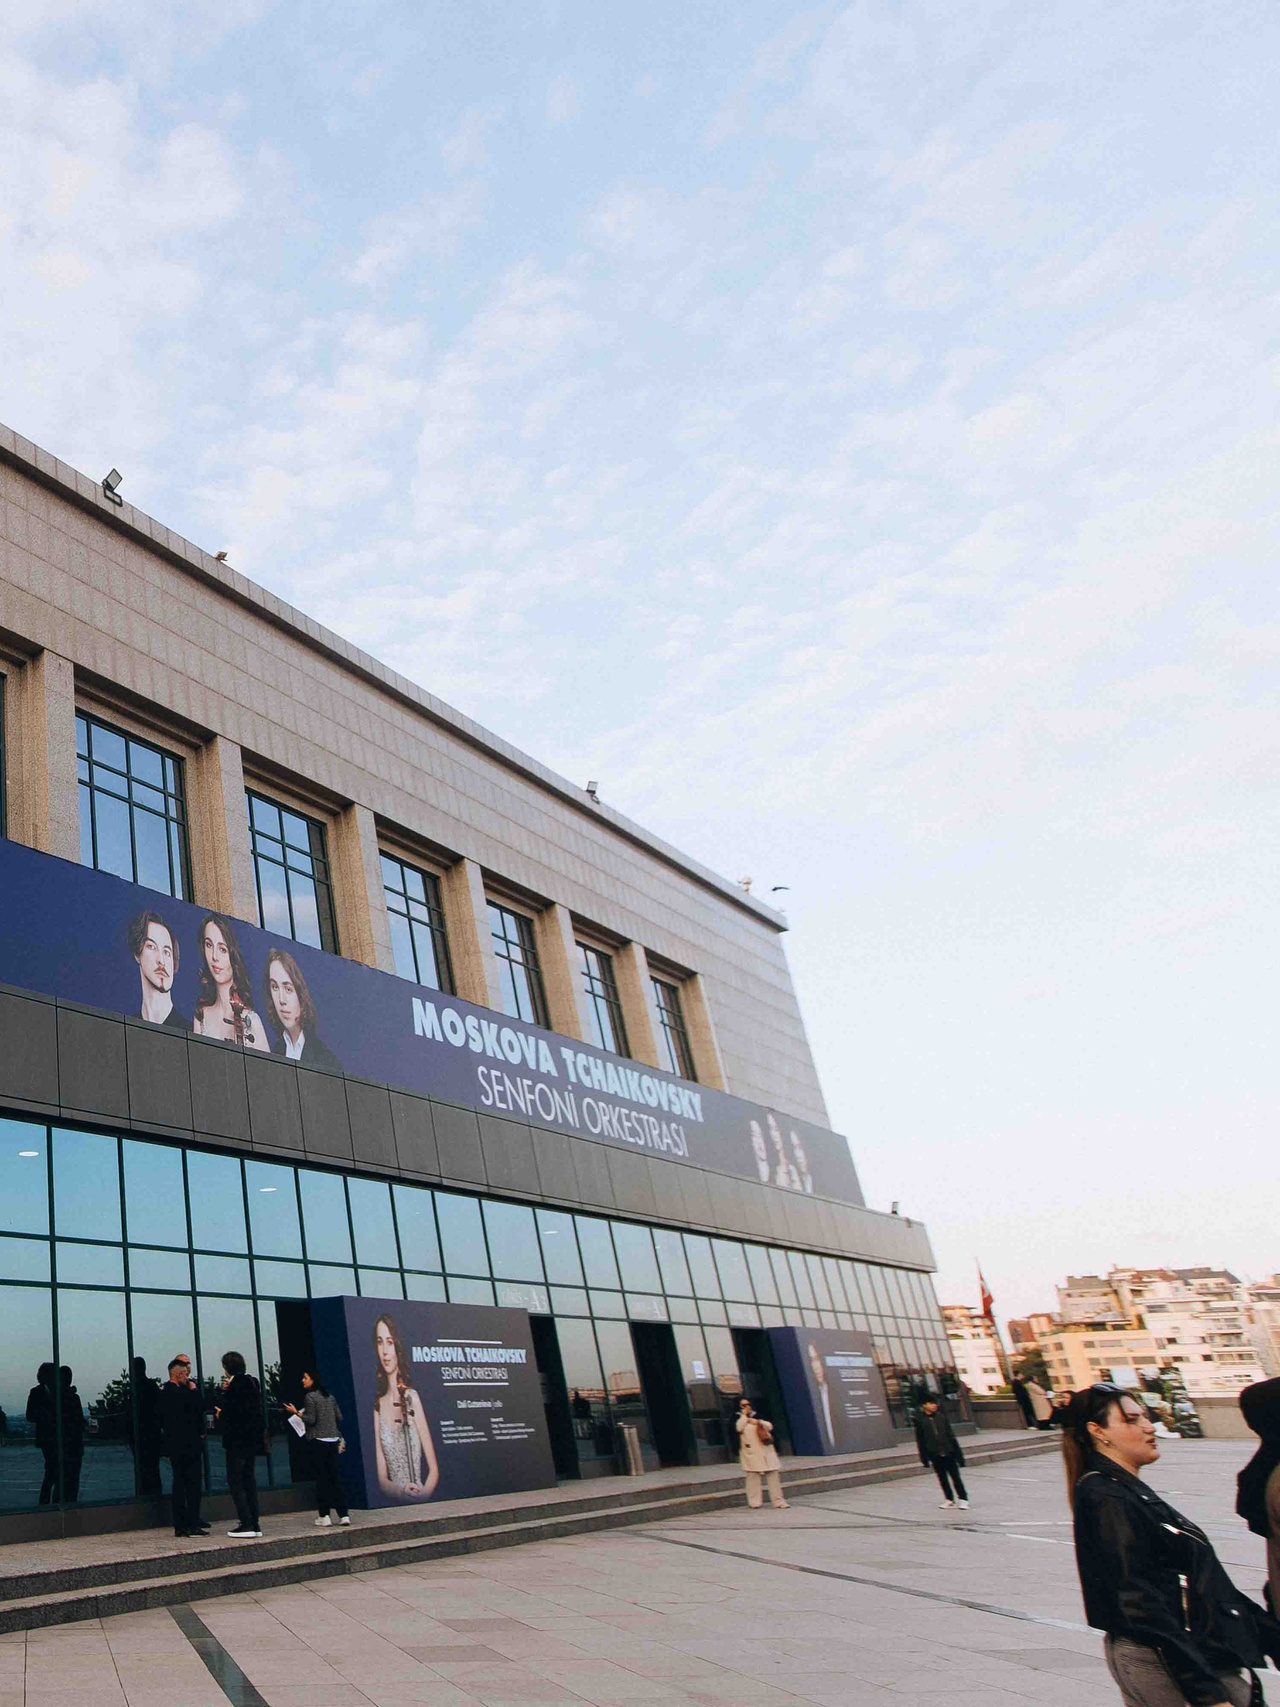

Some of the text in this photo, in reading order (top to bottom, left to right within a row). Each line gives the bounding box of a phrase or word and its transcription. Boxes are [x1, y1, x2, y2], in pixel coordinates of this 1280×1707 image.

[412, 997, 704, 1122] MOSKOVA TCHAIKOVSKY
[477, 1065, 689, 1157] SENFONİ ORKESTRASI
[412, 1346, 526, 1363] MOSKOVA TCHAIKOVSKY
[472, 1367, 508, 1379] ORKESTRASI
